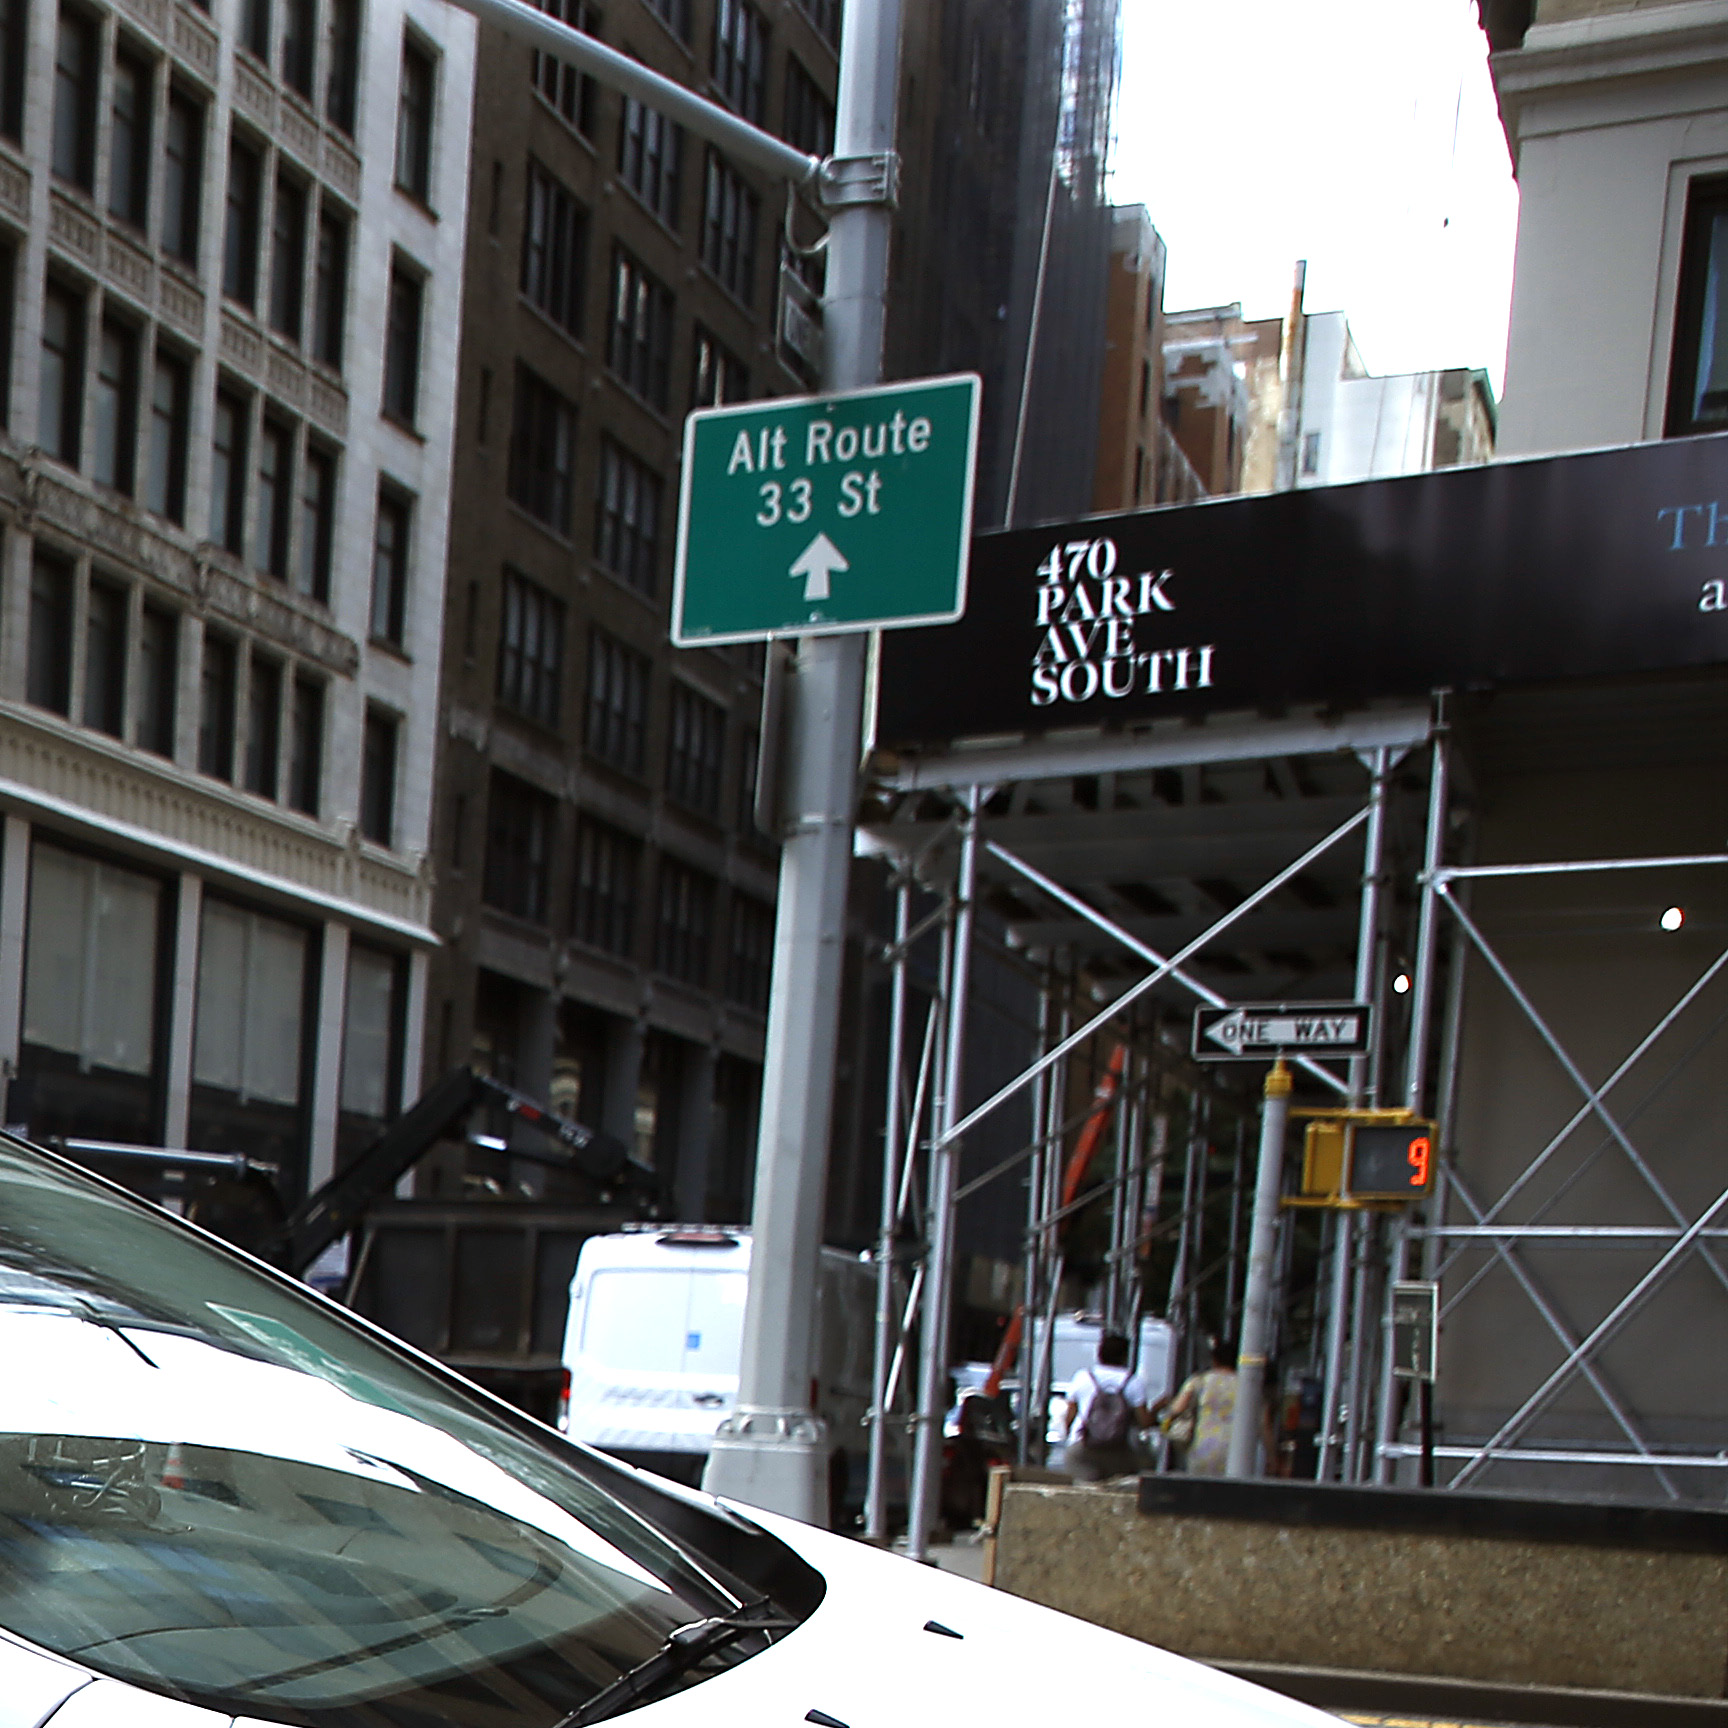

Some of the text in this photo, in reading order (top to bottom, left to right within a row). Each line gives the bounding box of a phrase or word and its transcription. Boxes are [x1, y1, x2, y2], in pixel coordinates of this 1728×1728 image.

[727, 408, 932, 476] Alt Route
[756, 469, 883, 527] 33 St
[1035, 536, 1118, 585] 470
[1034, 568, 1177, 626] PARK
[1031, 616, 1136, 667] AVE
[1030, 643, 1216, 707] SOUTH
[1222, 1017, 1348, 1043] ONE WAY
[1407, 1136, 1432, 1186] 9
